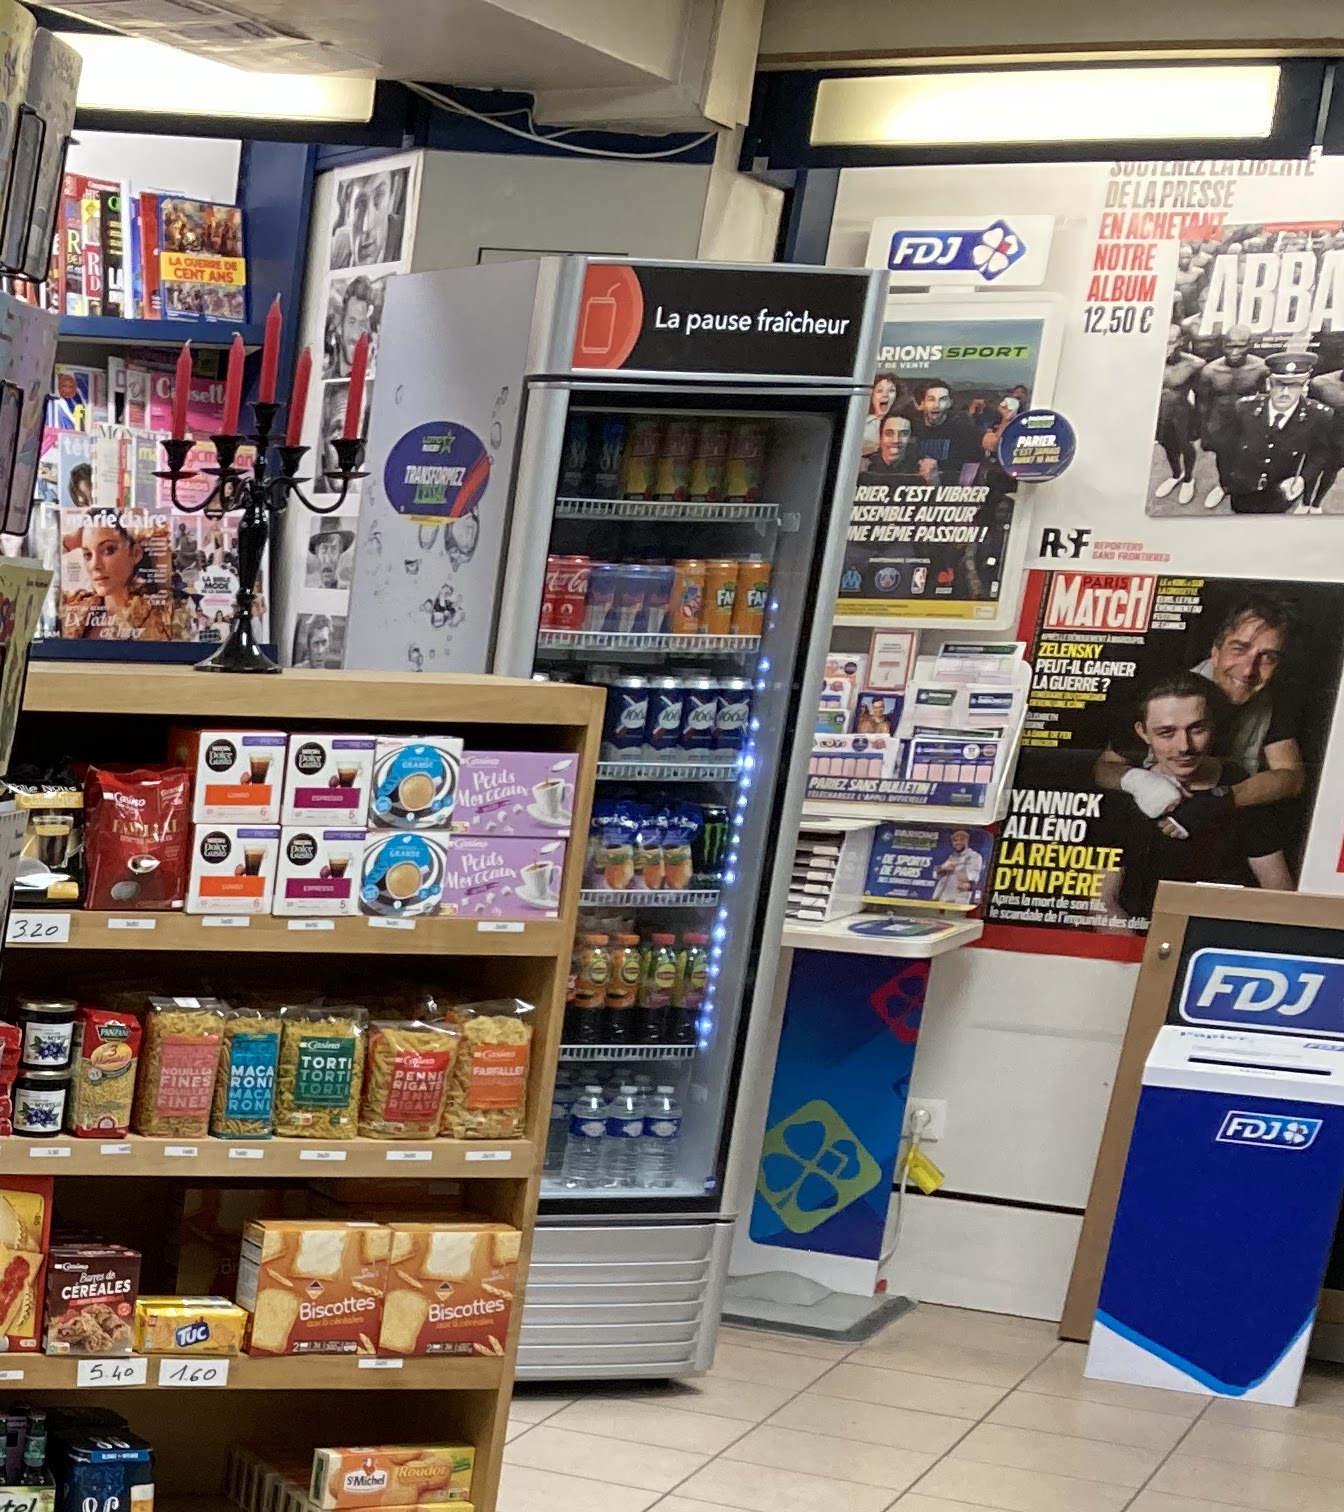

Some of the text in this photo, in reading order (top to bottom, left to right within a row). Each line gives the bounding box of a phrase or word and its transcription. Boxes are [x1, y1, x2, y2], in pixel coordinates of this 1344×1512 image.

[1105, 180, 1238, 209] DE LA PRESSE
[1098, 212, 1229, 241] EN ACHETANT
[893, 237, 964, 265] FDJ
[1092, 243, 1159, 271] NOTRE
[168, 257, 238, 271] LA GUERRE DE
[174, 268, 234, 284] CENT ANS
[1086, 275, 1159, 302] ALBUM
[655, 306, 850, 335] La pause fraîcheur
[1083, 306, 1138, 336] 12,50
[945, 345, 1028, 359] SPORT
[893, 486, 990, 504] C'EST VIBRER
[119, 511, 167, 529] claire
[914, 505, 977, 523] AUTOUR
[873, 523, 978, 543] MÊME PASSION
[1039, 528, 1092, 558] RSF
[1081, 577, 1131, 589] PARIS
[1049, 575, 1152, 629] MATCH
[1038, 642, 1104, 659] ZELENSKY
[1035, 659, 1136, 677] PEUT-IL GAGNER
[1032, 675, 1100, 692] LA GUERRE
[472, 769, 516, 789] Petits
[459, 786, 530, 807] Morceaux
[1010, 789, 1104, 818] YANNICK
[1001, 815, 1088, 843] ALLÉNO
[462, 852, 505, 873] Petits
[999, 841, 1124, 872] LA RÉVOLTE
[446, 867, 517, 889] Morceaux
[994, 867, 1048, 893] D'UN
[1197, 965, 1326, 1016] FDJ
[307, 1040, 341, 1050] Casino
[301, 1055, 352, 1070] TORTI
[159, 1075, 211, 1088] FINES
[1226, 1117, 1282, 1141] FDJ
[61, 1279, 132, 1301] CÉRÉALES
[299, 1296, 376, 1321] Biscottes
[428, 1299, 506, 1323] Biscottes
